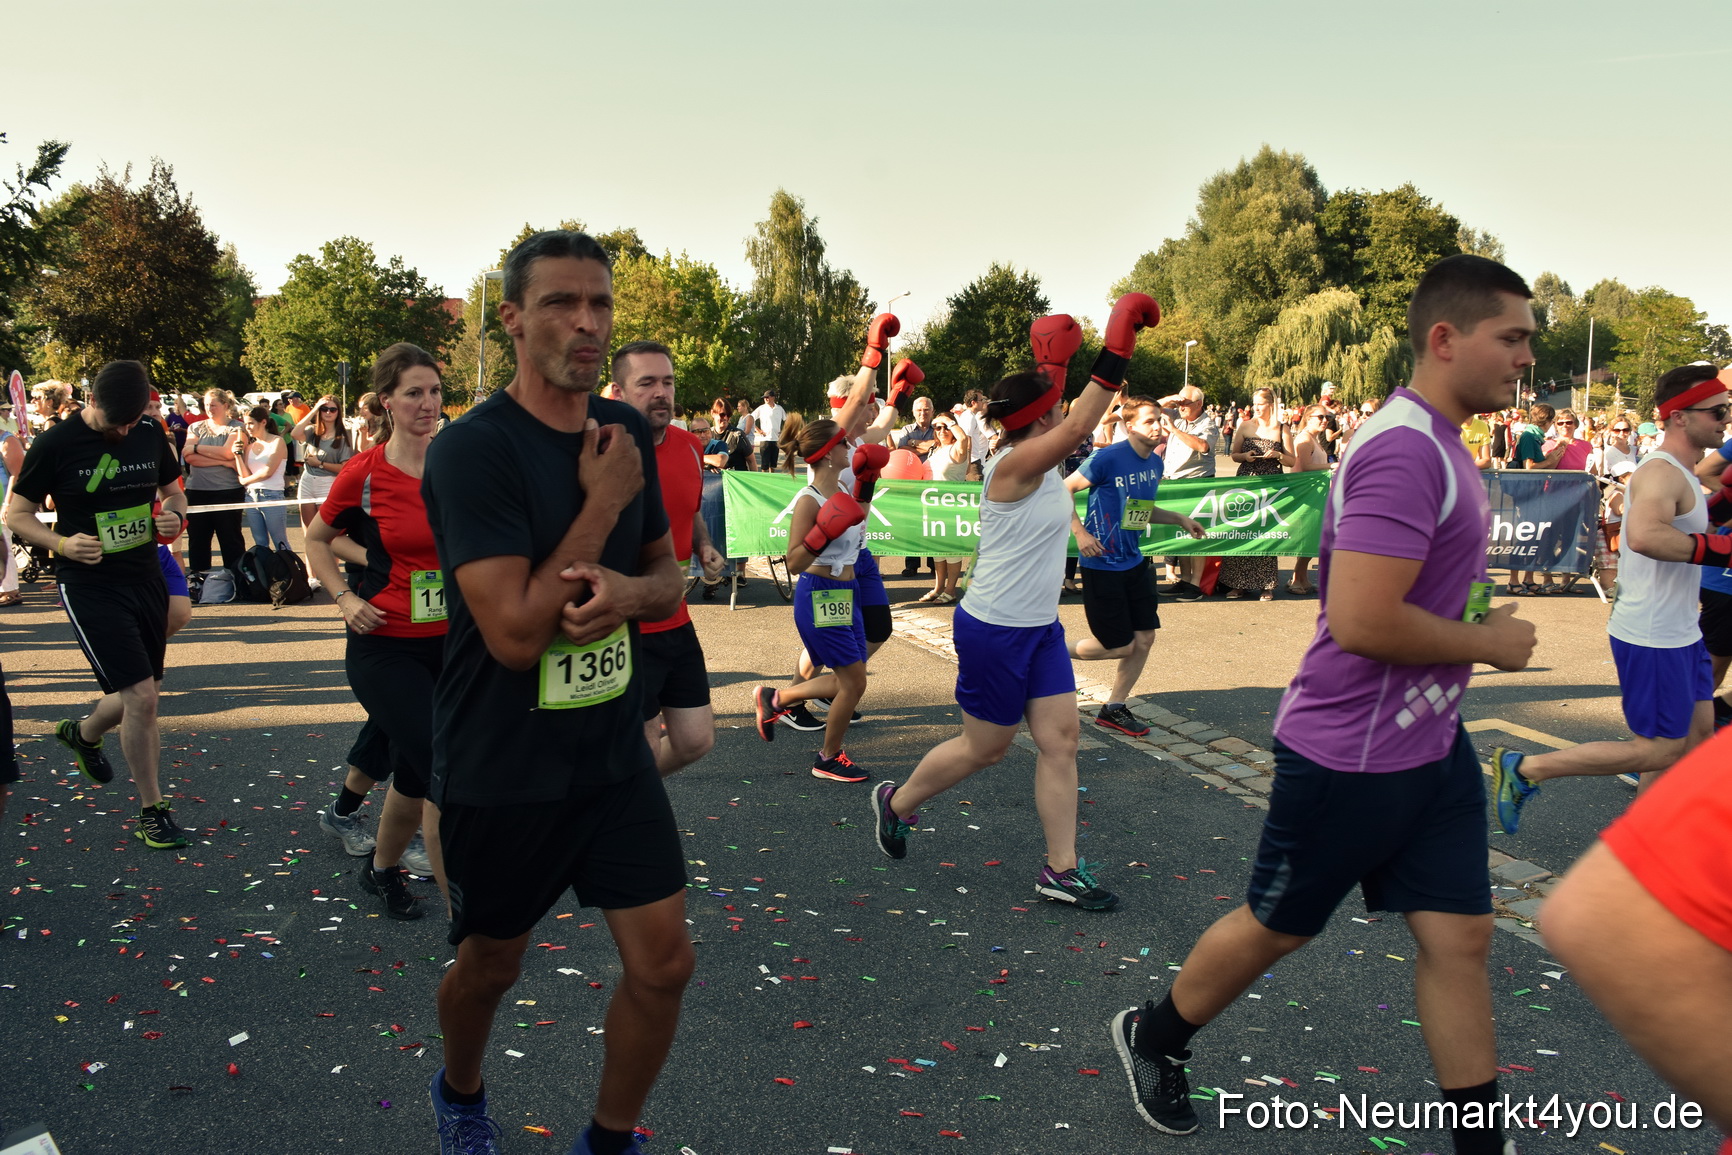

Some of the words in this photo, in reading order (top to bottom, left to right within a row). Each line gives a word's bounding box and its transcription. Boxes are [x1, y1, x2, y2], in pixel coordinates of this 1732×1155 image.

[1188, 487, 1290, 528] AOK
[107, 519, 146, 541] 1545
[769, 527, 788, 538] Die
[922, 515, 946, 537] in
[1175, 530, 1196, 540] Die
[1487, 514, 1552, 542] her
[820, 602, 850, 616] 1986
[557, 640, 625, 684] 1366
[1129, 1021, 1138, 1048] Reebok
